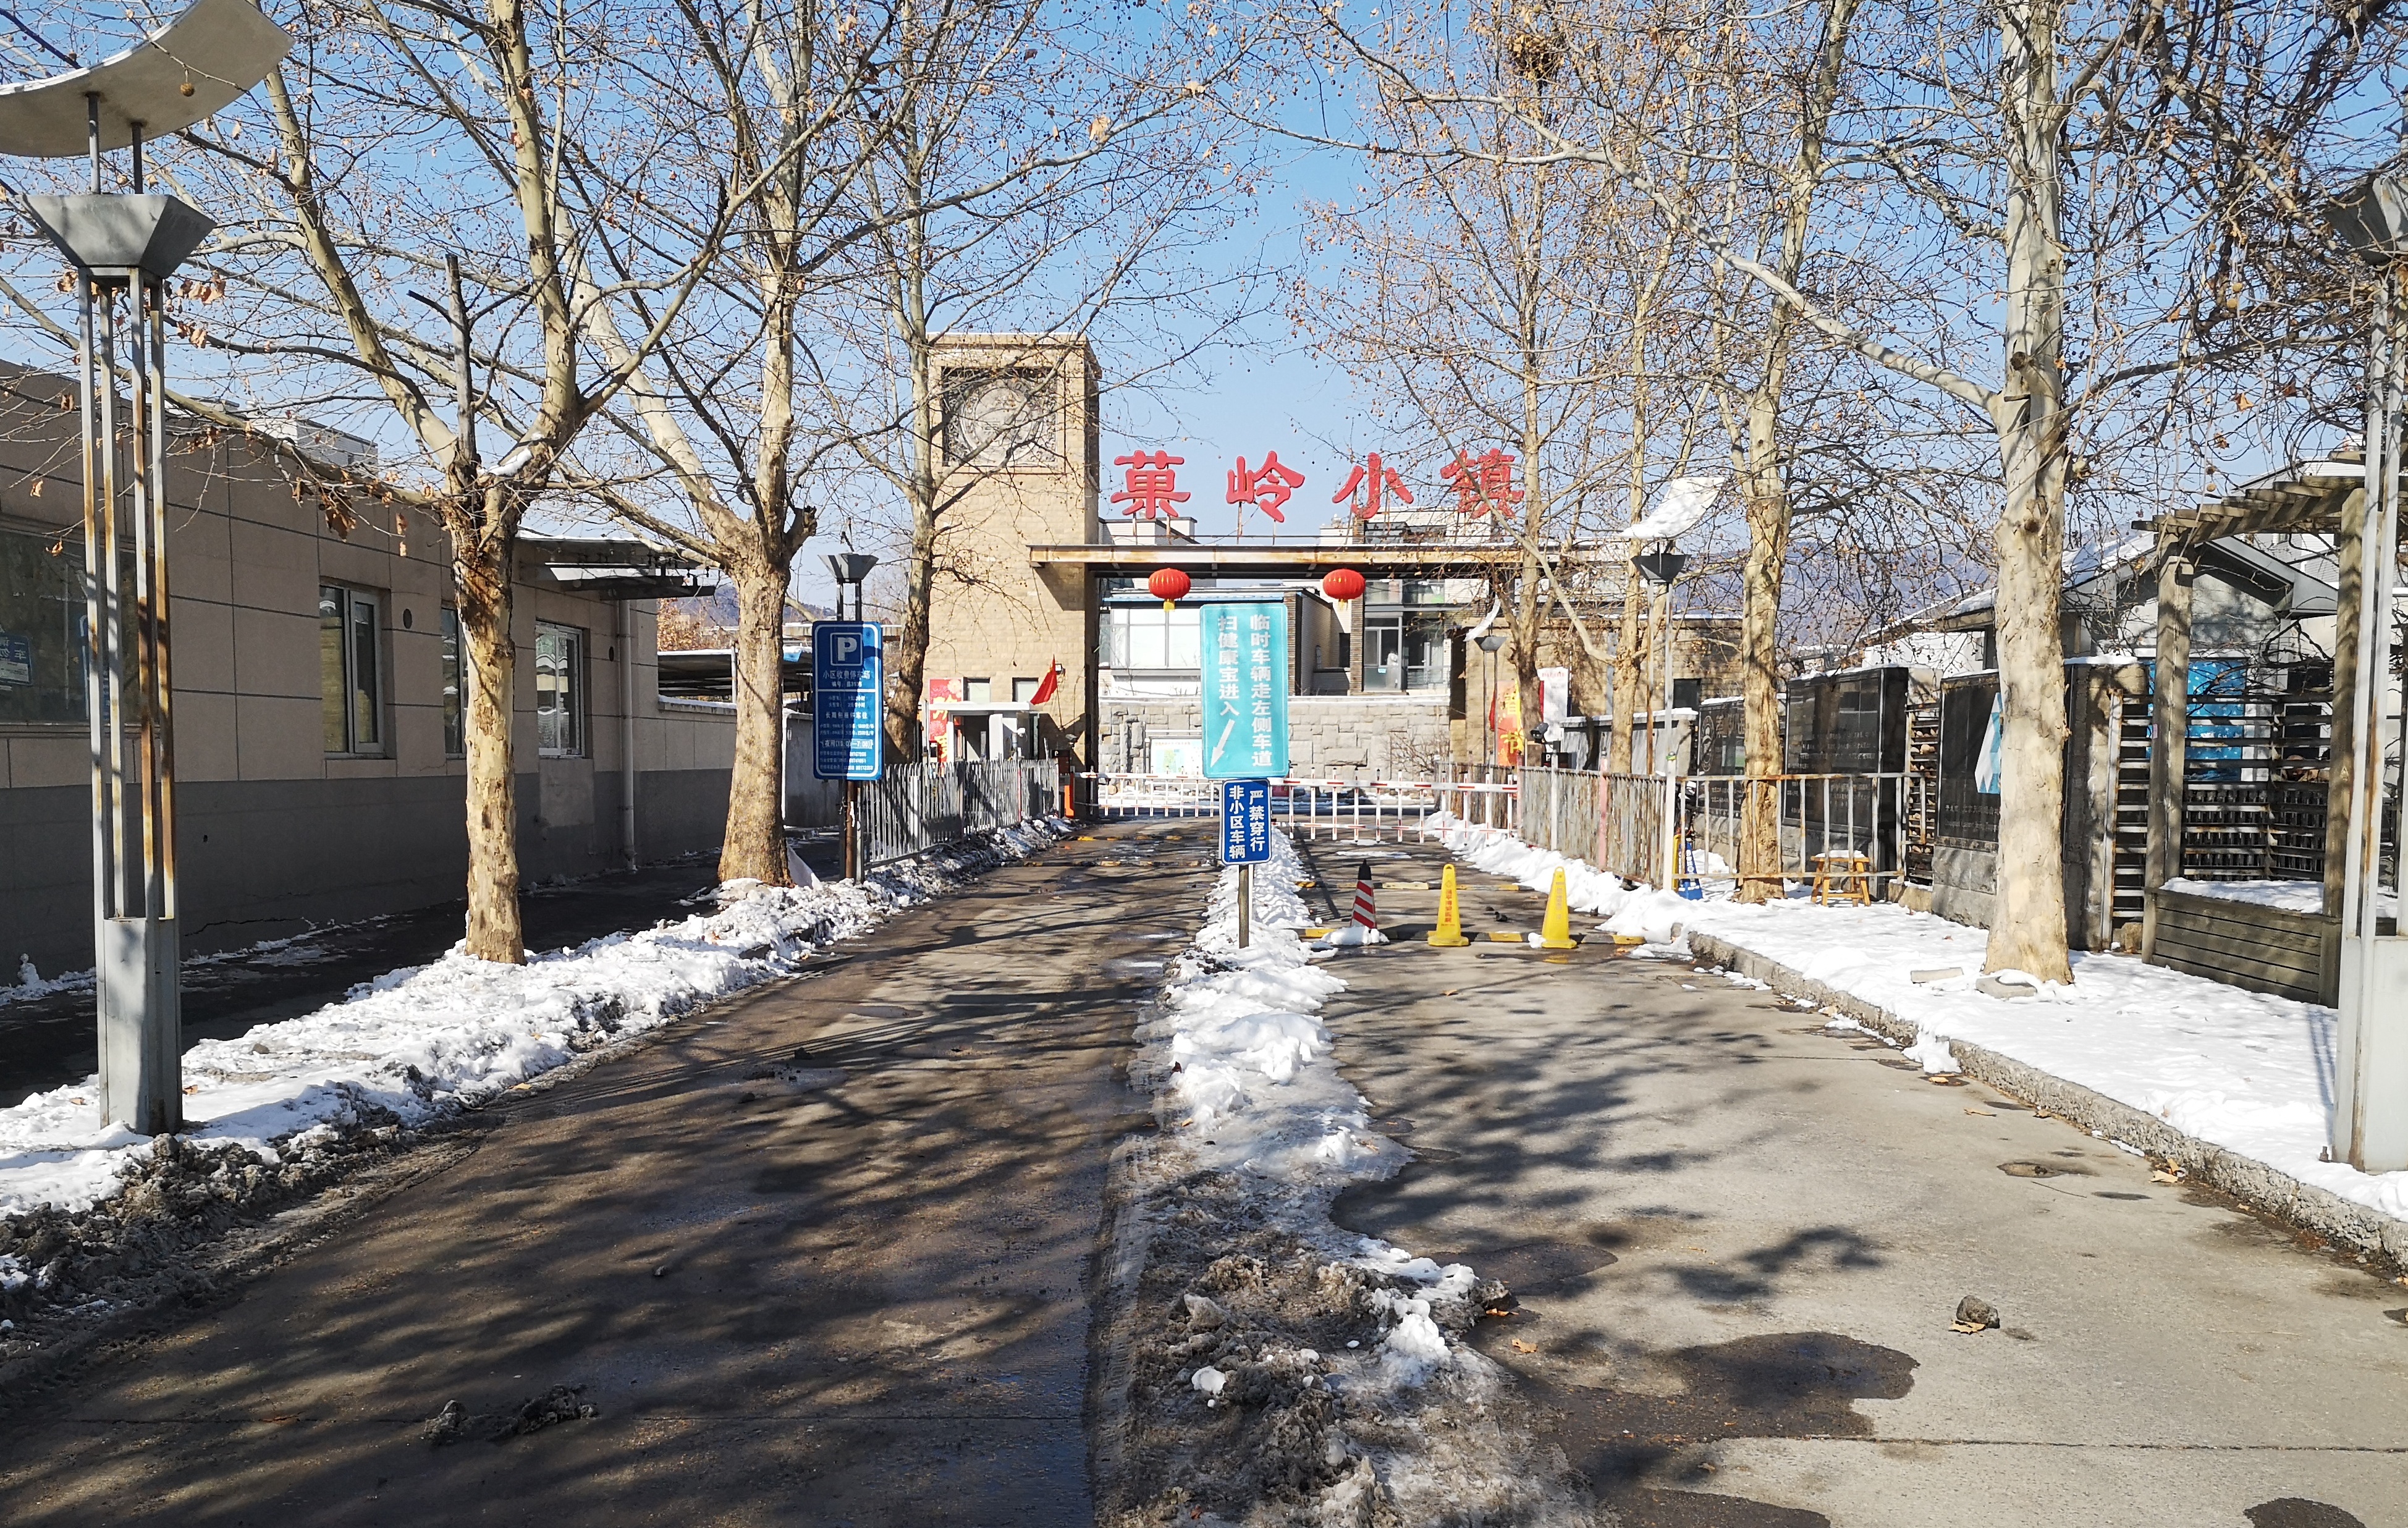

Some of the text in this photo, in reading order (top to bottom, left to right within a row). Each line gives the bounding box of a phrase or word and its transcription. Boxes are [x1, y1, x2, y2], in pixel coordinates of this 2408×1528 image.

[1110, 448, 1524, 523] 菓岭小镇
[837, 637, 858, 661] P
[1218, 615, 1240, 717] 扫健康宝进入
[1250, 614, 1272, 767] 临时车辆走左侧车道
[1229, 785, 1246, 859] 非小区车辆
[1249, 790, 1265, 852] 严禁穿行
